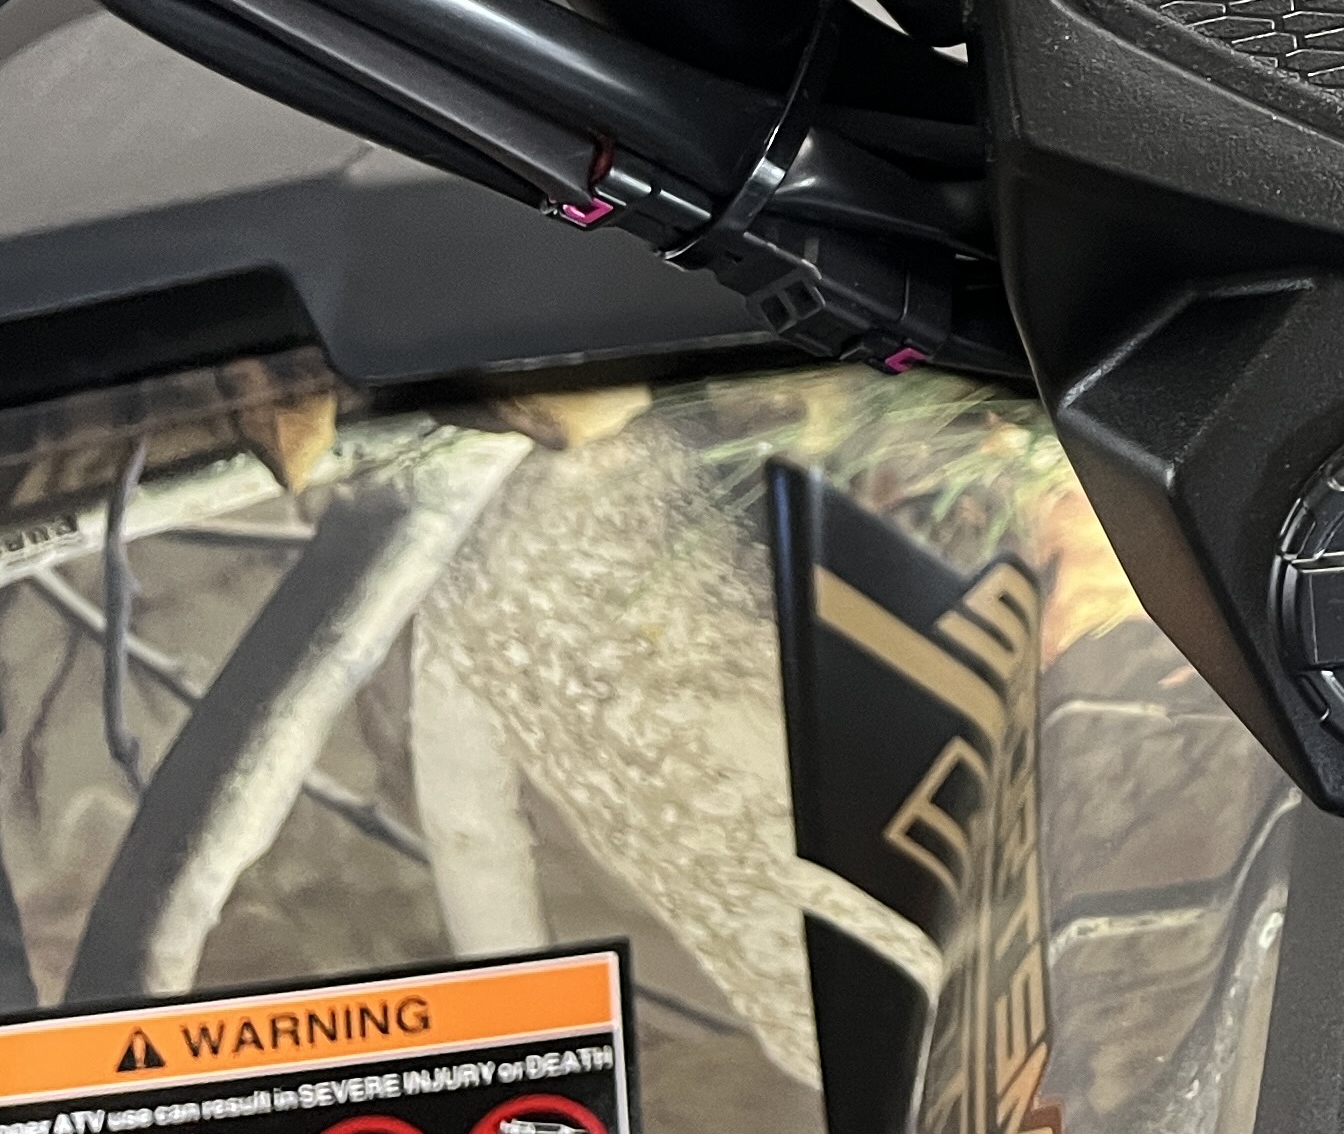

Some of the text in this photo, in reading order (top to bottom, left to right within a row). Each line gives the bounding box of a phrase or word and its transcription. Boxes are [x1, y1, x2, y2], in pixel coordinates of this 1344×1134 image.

[182, 995, 432, 1058] WARNING
[50, 1108, 107, 1134] ATV
[300, 1073, 402, 1109] SEVERE
[402, 1059, 496, 1096] INJURY
[497, 1061, 525, 1084] or
[525, 1044, 614, 1080] DEATH
